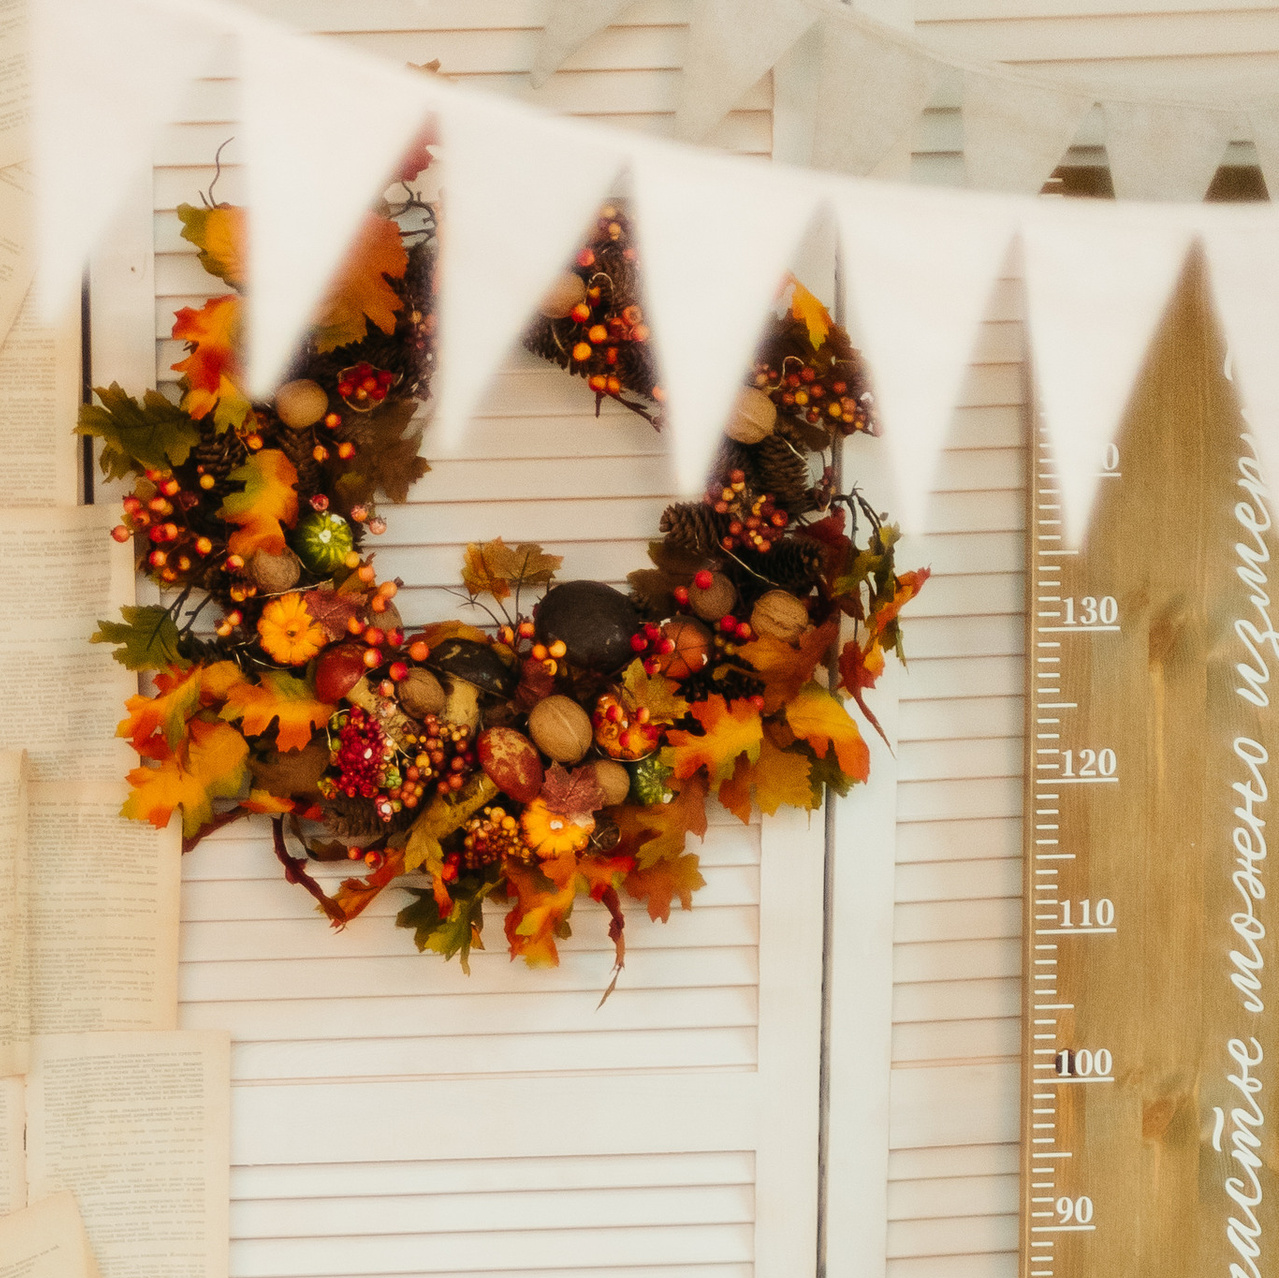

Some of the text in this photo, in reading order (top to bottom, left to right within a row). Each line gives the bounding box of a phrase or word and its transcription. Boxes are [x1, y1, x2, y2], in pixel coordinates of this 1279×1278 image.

[1223, 342, 1279, 707] измер
[1061, 595, 1119, 625] 130
[1060, 748, 1117, 777] 120
[1229, 736, 1270, 1013] можно
[1059, 898, 1115, 927] 110
[1057, 1048, 1113, 1077] 100
[1055, 1195, 1094, 1224] 90
